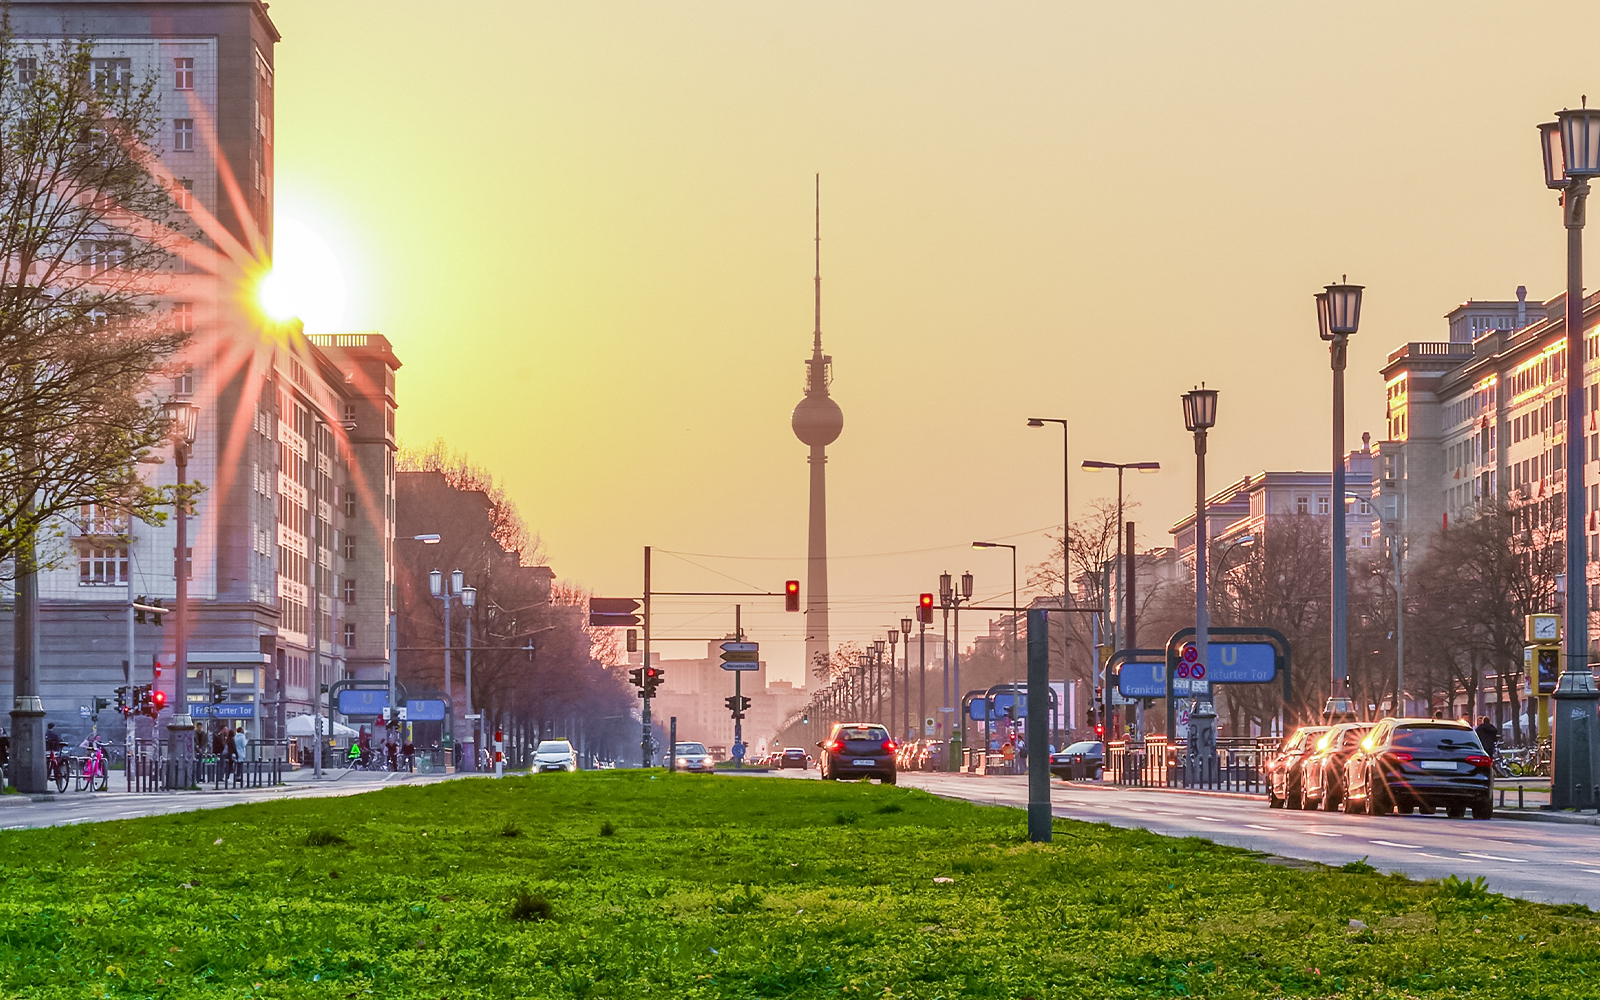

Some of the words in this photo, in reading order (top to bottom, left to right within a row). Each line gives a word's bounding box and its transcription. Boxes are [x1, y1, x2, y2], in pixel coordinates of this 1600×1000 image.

[1221, 647, 1237, 666] U
[1152, 666, 1166, 683] U
[1251, 669, 1268, 679] Tor
[240, 706, 252, 714] Tor
